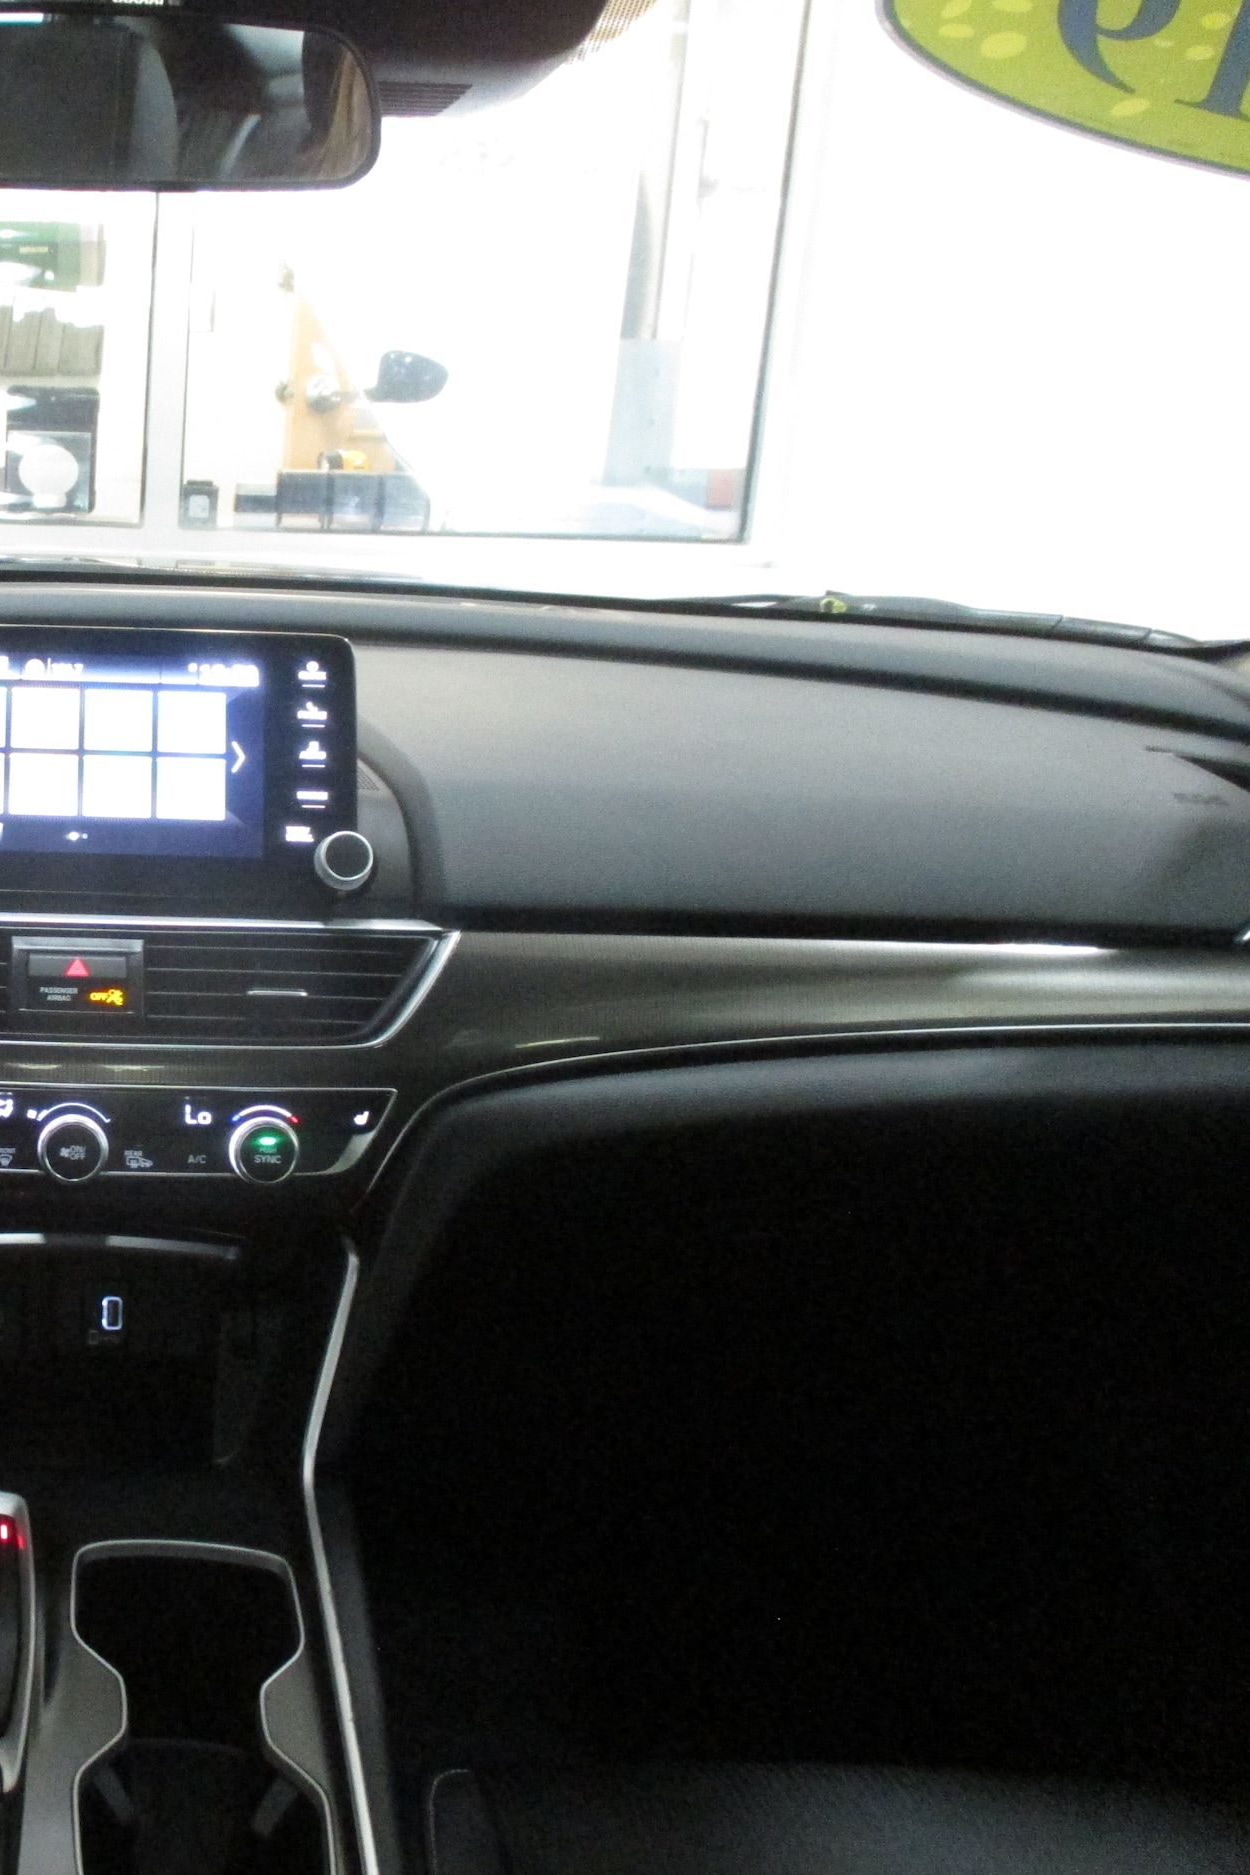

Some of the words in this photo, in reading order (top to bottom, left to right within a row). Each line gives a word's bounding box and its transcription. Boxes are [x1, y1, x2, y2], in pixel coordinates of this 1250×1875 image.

[39, 986, 79, 995] PASSENGER
[46, 994, 72, 1002] AIRBAG
[90, 992, 109, 1001] OFF
[185, 1104, 212, 1125] Lo
[187, 1154, 207, 1164] A/C
[253, 1155, 281, 1164] SYNC
